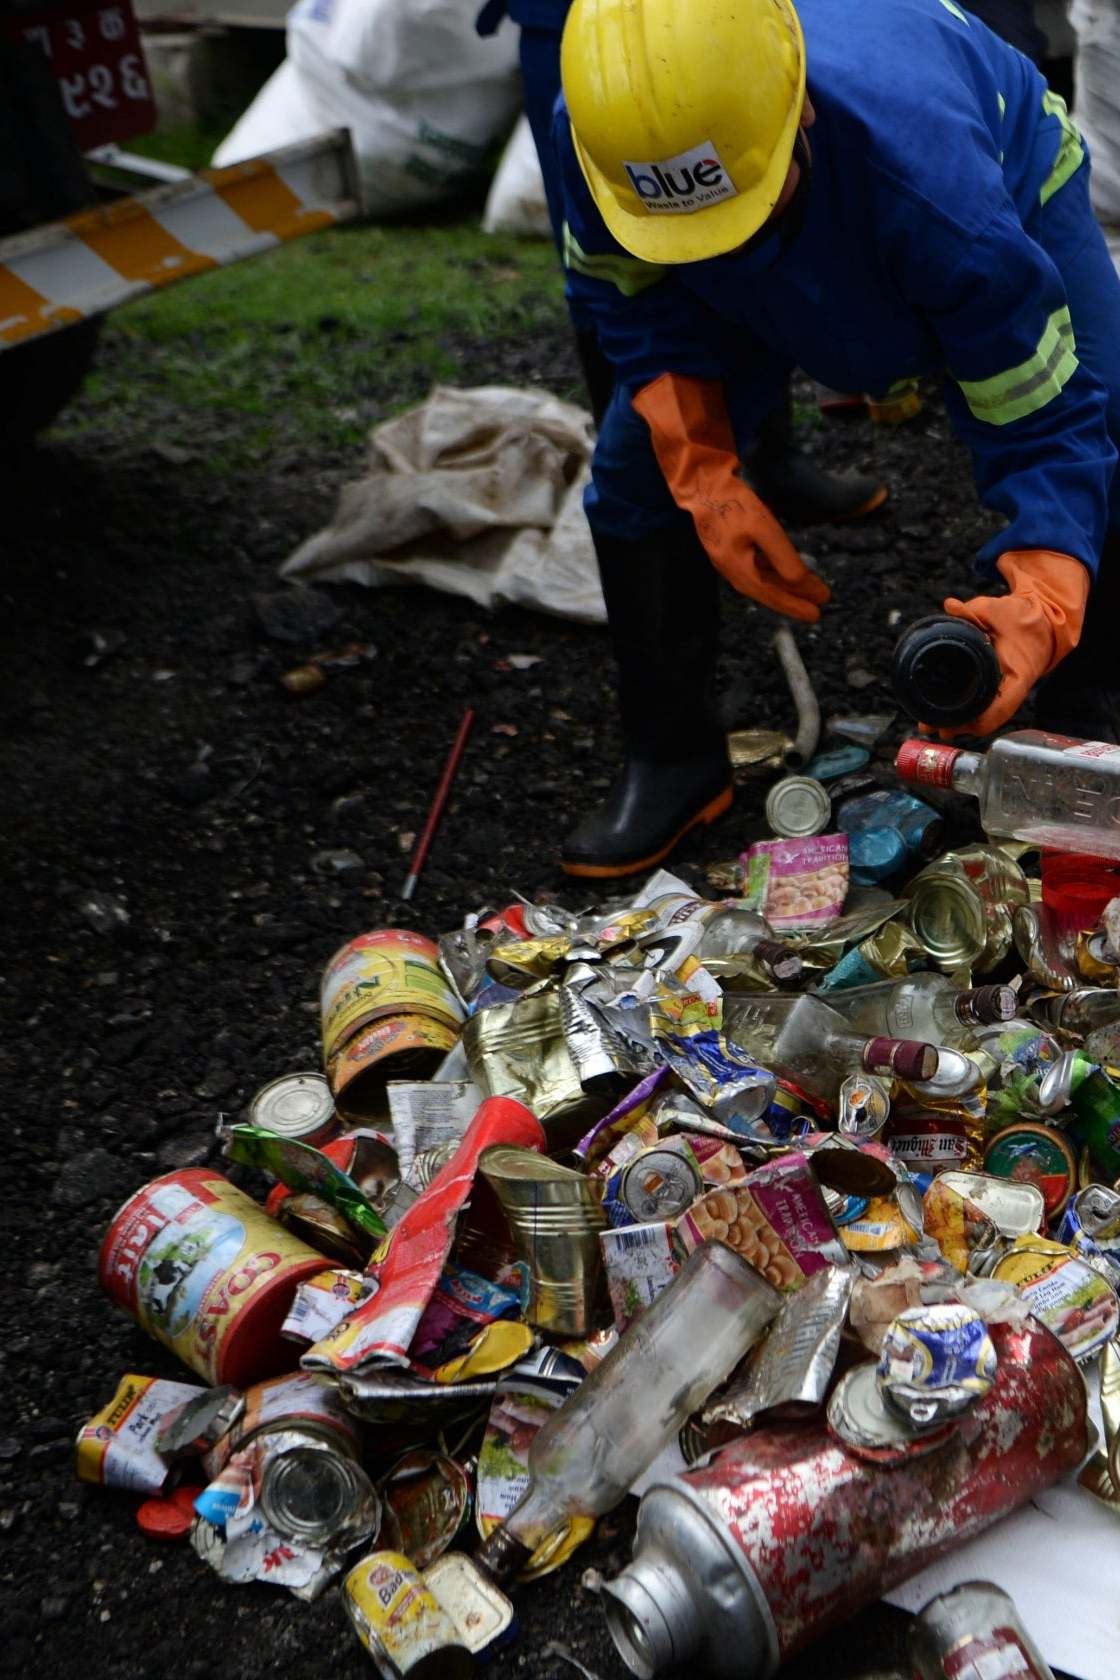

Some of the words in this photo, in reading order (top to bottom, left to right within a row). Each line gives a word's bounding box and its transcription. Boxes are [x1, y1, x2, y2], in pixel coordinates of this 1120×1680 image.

[624, 158, 723, 199] blue
[646, 200, 680, 210] Waste
[682, 199, 695, 209] to
[697, 185, 730, 203] Value
[890, 1136, 938, 1158] Miguel
[938, 1136, 966, 1157] San
